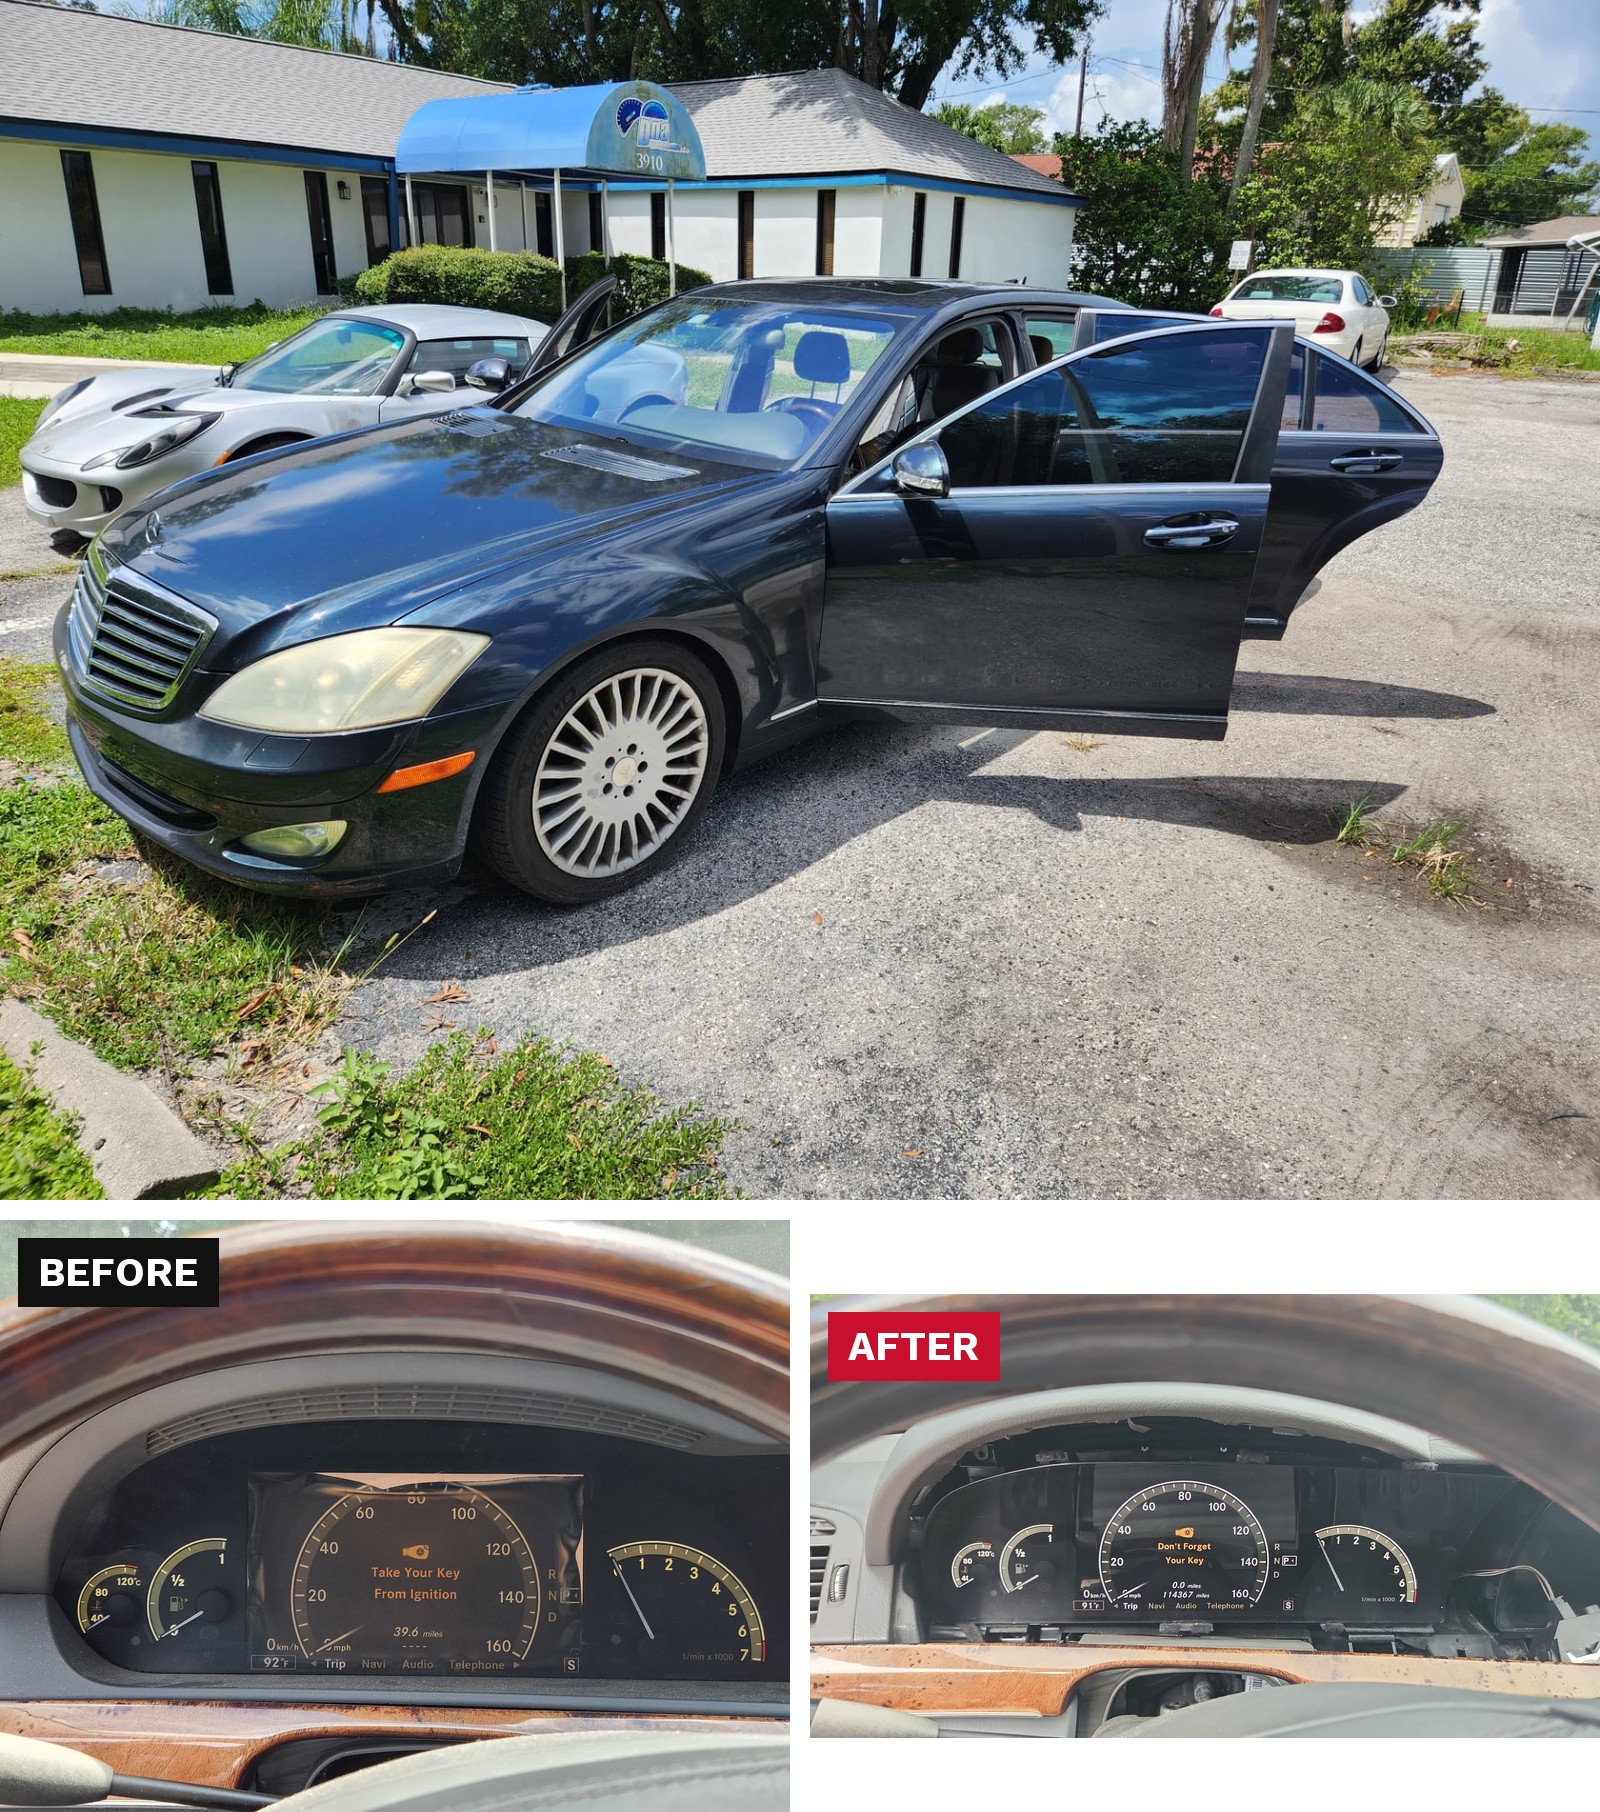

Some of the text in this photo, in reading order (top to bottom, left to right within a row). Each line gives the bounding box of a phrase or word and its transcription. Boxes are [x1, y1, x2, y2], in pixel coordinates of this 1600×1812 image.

[636, 153, 663, 171] 3910
[1178, 1491, 1192, 1501] 80
[1142, 1502, 1156, 1511] 60
[1208, 1502, 1226, 1512] 100
[355, 1507, 374, 1519] 60
[451, 1507, 476, 1520] 100
[1118, 1526, 1131, 1535] 40
[1233, 1526, 1250, 1535] 120
[1048, 1534, 1052, 1543] 1
[1336, 1536, 1340, 1545] 1
[1353, 1536, 1359, 1545] 2
[319, 1541, 339, 1555] 40
[486, 1543, 510, 1556] 120
[1158, 1542, 1211, 1552] Don't Forget
[1274, 1543, 1280, 1551] R
[1370, 1541, 1376, 1551] 3
[219, 1553, 225, 1565] 1
[1274, 1557, 1280, 1565] N
[1283, 1557, 1290, 1565] P
[1383, 1552, 1390, 1560] 4
[639, 1558, 645, 1570] 1
[665, 1559, 673, 1571] 2
[1110, 1557, 1124, 1567] 20
[1187, 1557, 1204, 1566] Key
[1240, 1558, 1258, 1567] 140
[371, 1567, 460, 1580] Take Your Key
[549, 1569, 556, 1579] R
[690, 1567, 699, 1579] 3
[1393, 1565, 1400, 1574] 5
[1273, 1571, 1280, 1579] D
[1399, 1578, 1405, 1587] 6
[95, 1588, 108, 1597] 80
[711, 1583, 721, 1595] 4
[1232, 1589, 1249, 1598] 160
[308, 1589, 327, 1602] 20
[374, 1588, 457, 1602] From Ignition
[499, 1591, 524, 1603] 140
[549, 1591, 557, 1601] N
[1400, 1594, 1406, 1603] 7
[728, 1604, 737, 1616] 5
[1123, 1603, 1138, 1611] Trip
[1175, 1602, 1197, 1610] Audio
[1207, 1602, 1244, 1611] Telephone
[1286, 1601, 1292, 1609] S
[549, 1612, 556, 1622] D
[393, 1627, 443, 1638] 39.6 miles
[738, 1625, 747, 1637] 6
[486, 1640, 511, 1652] 160
[682, 1653, 705, 1661] 1/min
[714, 1653, 734, 1661] 1000
[740, 1649, 749, 1661] 7
[263, 1657, 289, 1668] 92°F
[325, 1659, 505, 1671] Trip Navi Audio Telephone
[568, 1660, 575, 1671] S
